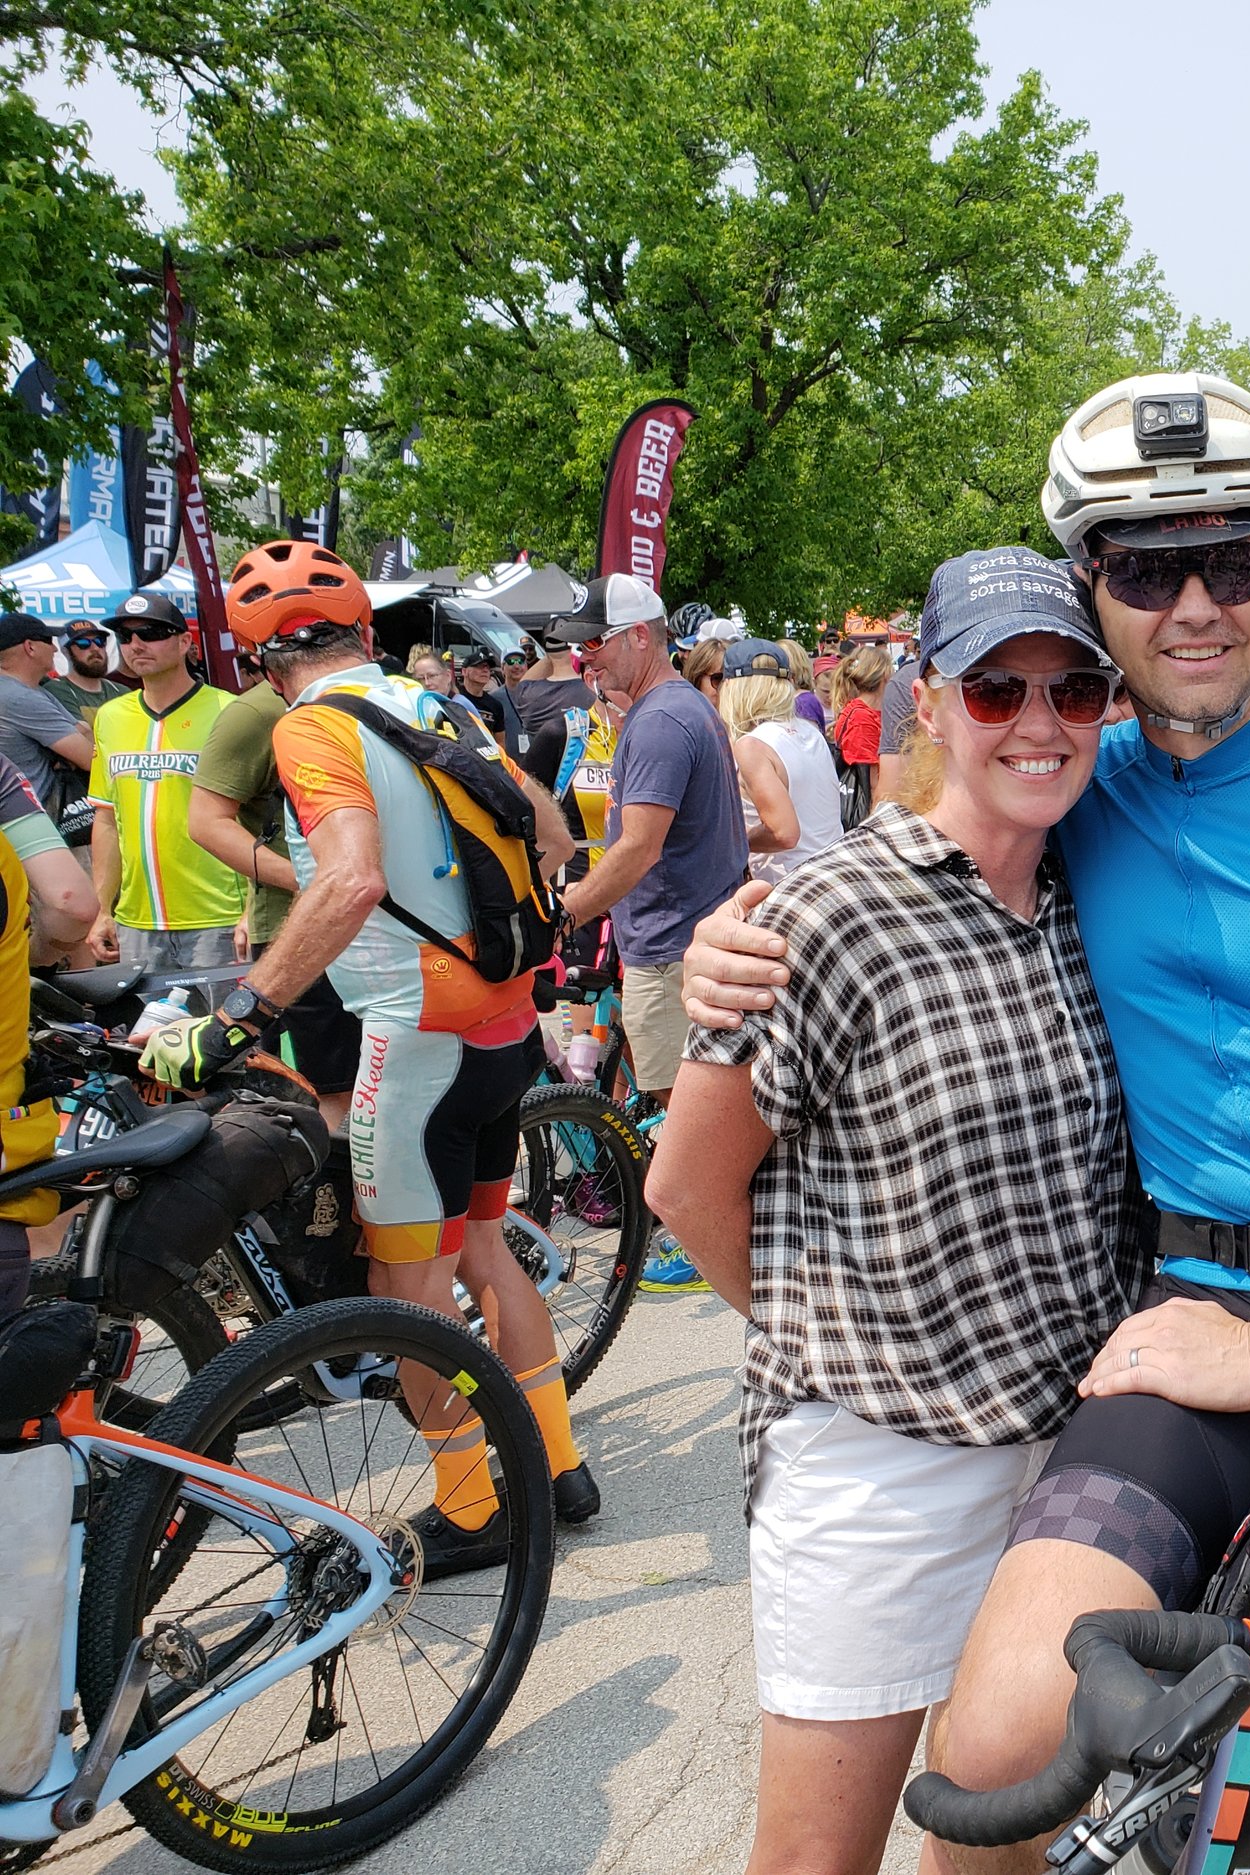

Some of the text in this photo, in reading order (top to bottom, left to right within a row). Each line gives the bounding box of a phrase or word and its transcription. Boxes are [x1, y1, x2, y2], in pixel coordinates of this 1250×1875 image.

[635, 419, 676, 501] BEER
[378, 550, 397, 581] MIN
[969, 556, 1018, 573] sorta
[15, 591, 110, 614] ATEC
[970, 579, 1080, 609] sorta savage
[110, 753, 198, 774] MULREADY'S
[141, 769, 161, 779] PUB
[79, 1106, 116, 1140] 90
[600, 1111, 642, 1161] MAXXIS
[352, 1112, 376, 1181] CHILE
[354, 1181, 378, 1199] RON
[168, 1763, 187, 1784] DT
[184, 1780, 216, 1810] SWISS
[156, 1771, 254, 1848] MAXXIS
